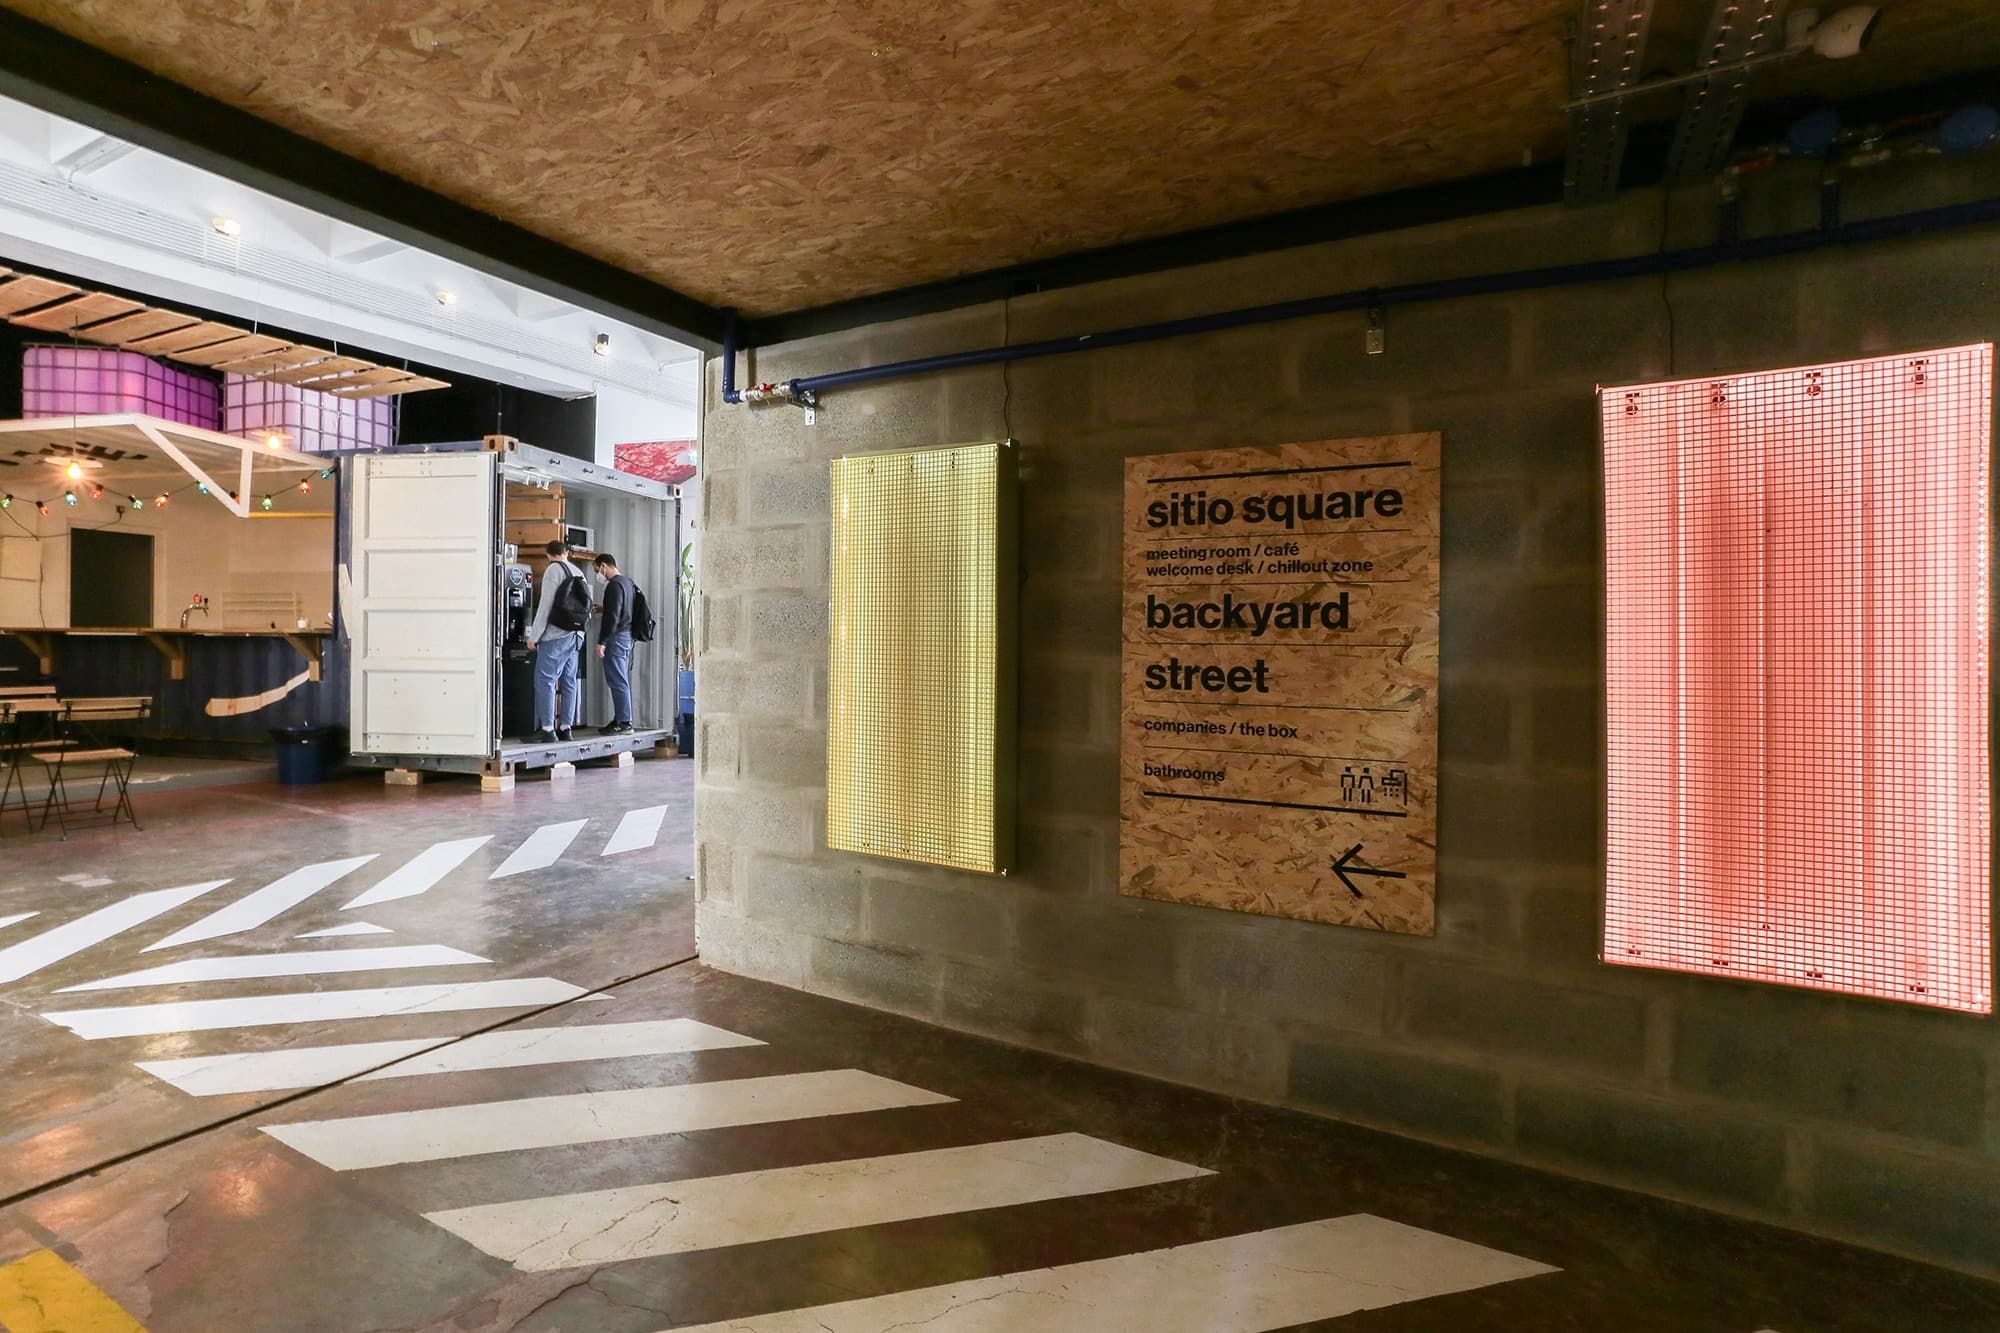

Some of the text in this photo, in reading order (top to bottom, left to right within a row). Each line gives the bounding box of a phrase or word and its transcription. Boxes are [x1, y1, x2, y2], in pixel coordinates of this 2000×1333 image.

[1146, 489, 1403, 529] sitio square
[1146, 542, 1299, 561] meeting room / café
[1146, 560, 1373, 576] welcome desk / chillout zone
[1147, 592, 1349, 637] backyard
[1145, 658, 1269, 693] street
[1144, 720, 1298, 738] companies / the box
[1144, 763, 1225, 782] bathrooms
